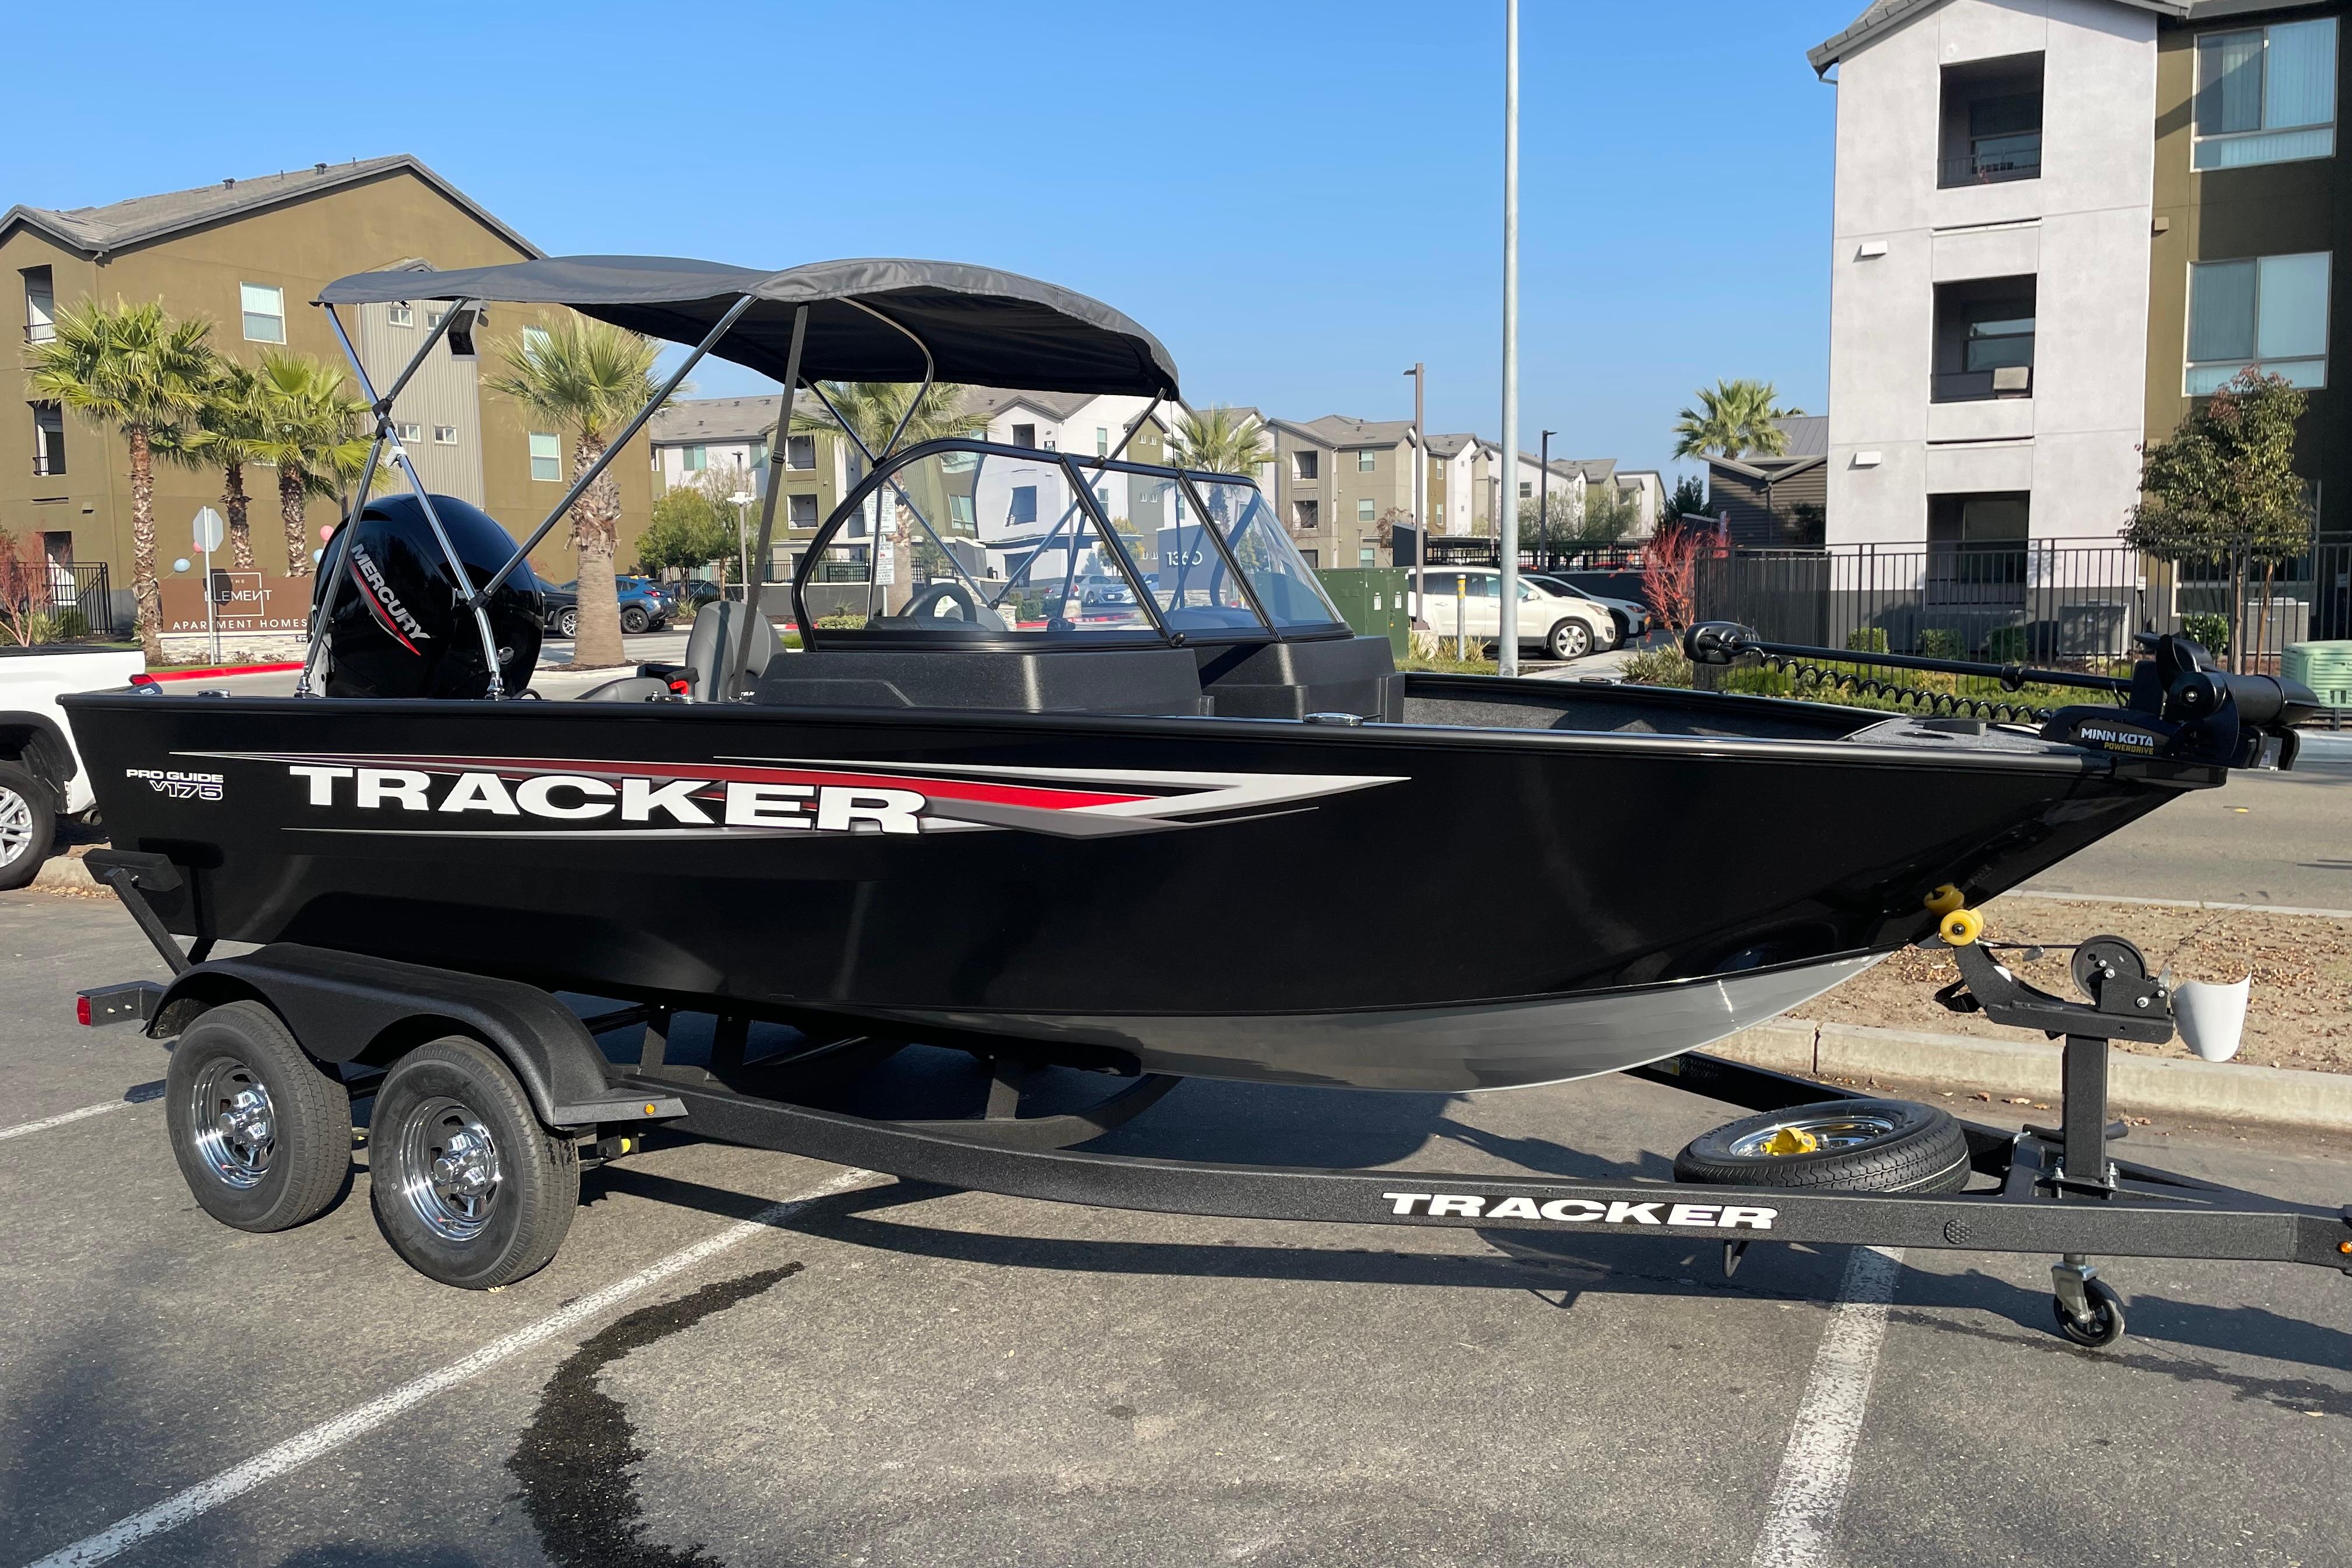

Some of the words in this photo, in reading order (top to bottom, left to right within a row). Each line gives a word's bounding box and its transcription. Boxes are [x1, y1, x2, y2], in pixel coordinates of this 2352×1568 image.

[351, 543, 430, 639] MERCURY
[172, 619, 252, 630] APARMENT
[260, 618, 307, 628] HOMES
[2081, 727, 2116, 741] MINN
[2118, 732, 2154, 747] KOTA
[2104, 742, 2154, 755] POWERDRIVE
[126, 769, 164, 779] PRO
[166, 771, 223, 783] GUIDE
[149, 780, 223, 801] V175
[289, 765, 928, 834] TRACKER
[1382, 1192, 1778, 1229] TRACKER
